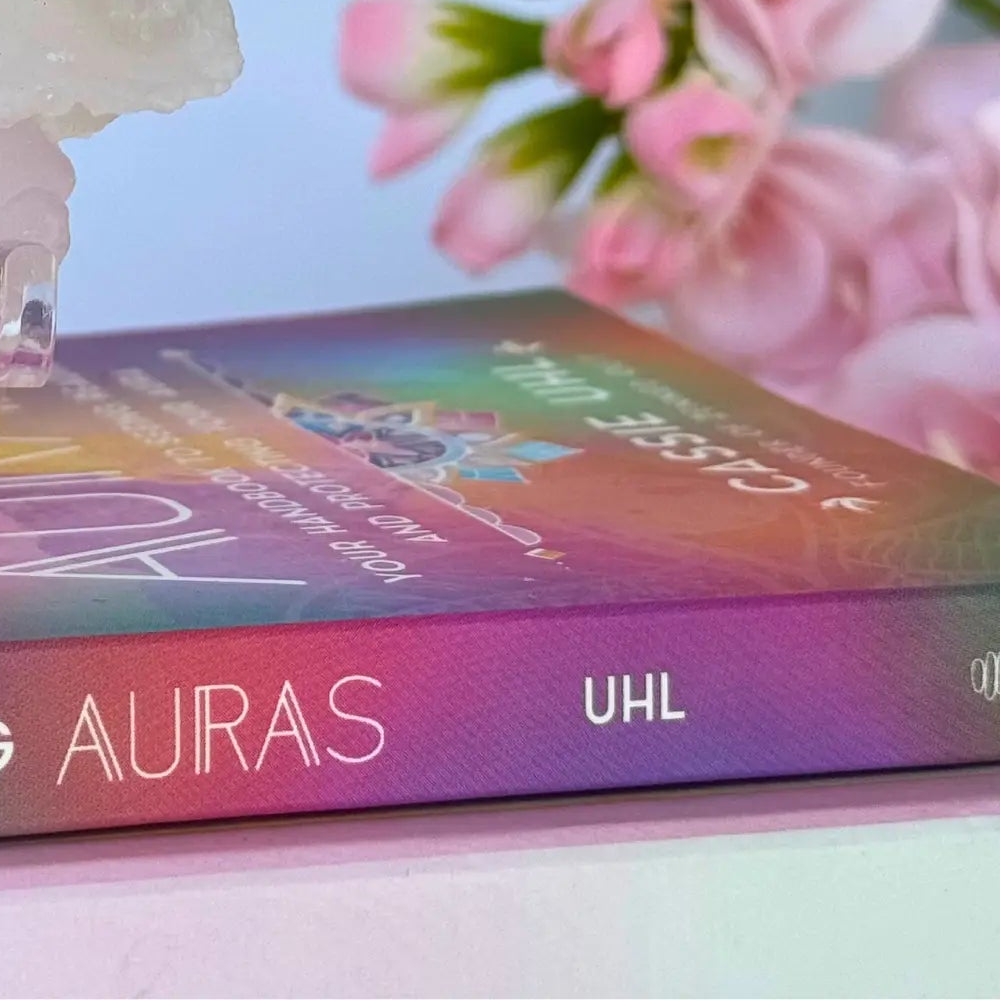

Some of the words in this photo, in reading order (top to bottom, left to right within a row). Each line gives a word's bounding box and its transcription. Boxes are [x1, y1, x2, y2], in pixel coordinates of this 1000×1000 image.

[583, 411, 810, 494] CASSIE
[197, 466, 349, 536] HANDBOOK
[367, 514, 449, 544] AND
[329, 539, 422, 584] YOUR
[56, 674, 386, 785] AURAS
[584, 671, 686, 725] UHL
